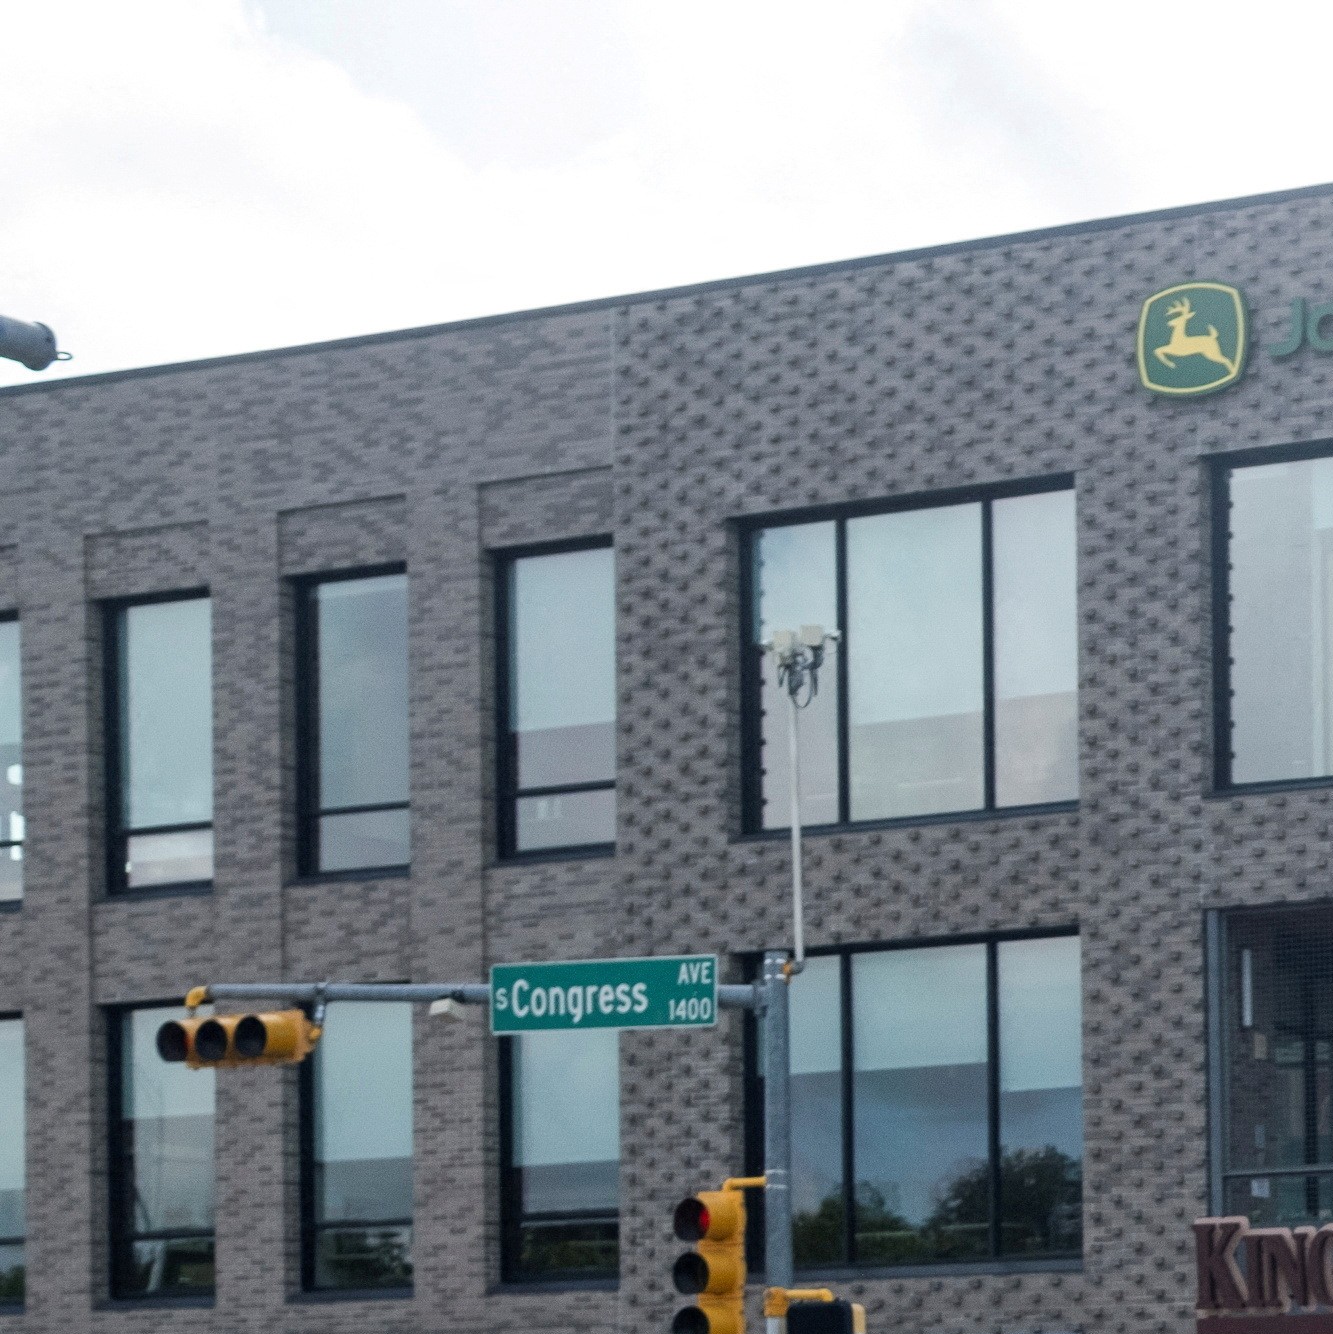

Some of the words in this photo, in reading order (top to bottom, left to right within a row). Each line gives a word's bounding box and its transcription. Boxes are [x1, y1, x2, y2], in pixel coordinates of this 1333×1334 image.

[677, 962, 712, 985] AVE
[512, 979, 649, 1024] Congress
[669, 997, 712, 1021] 1400
